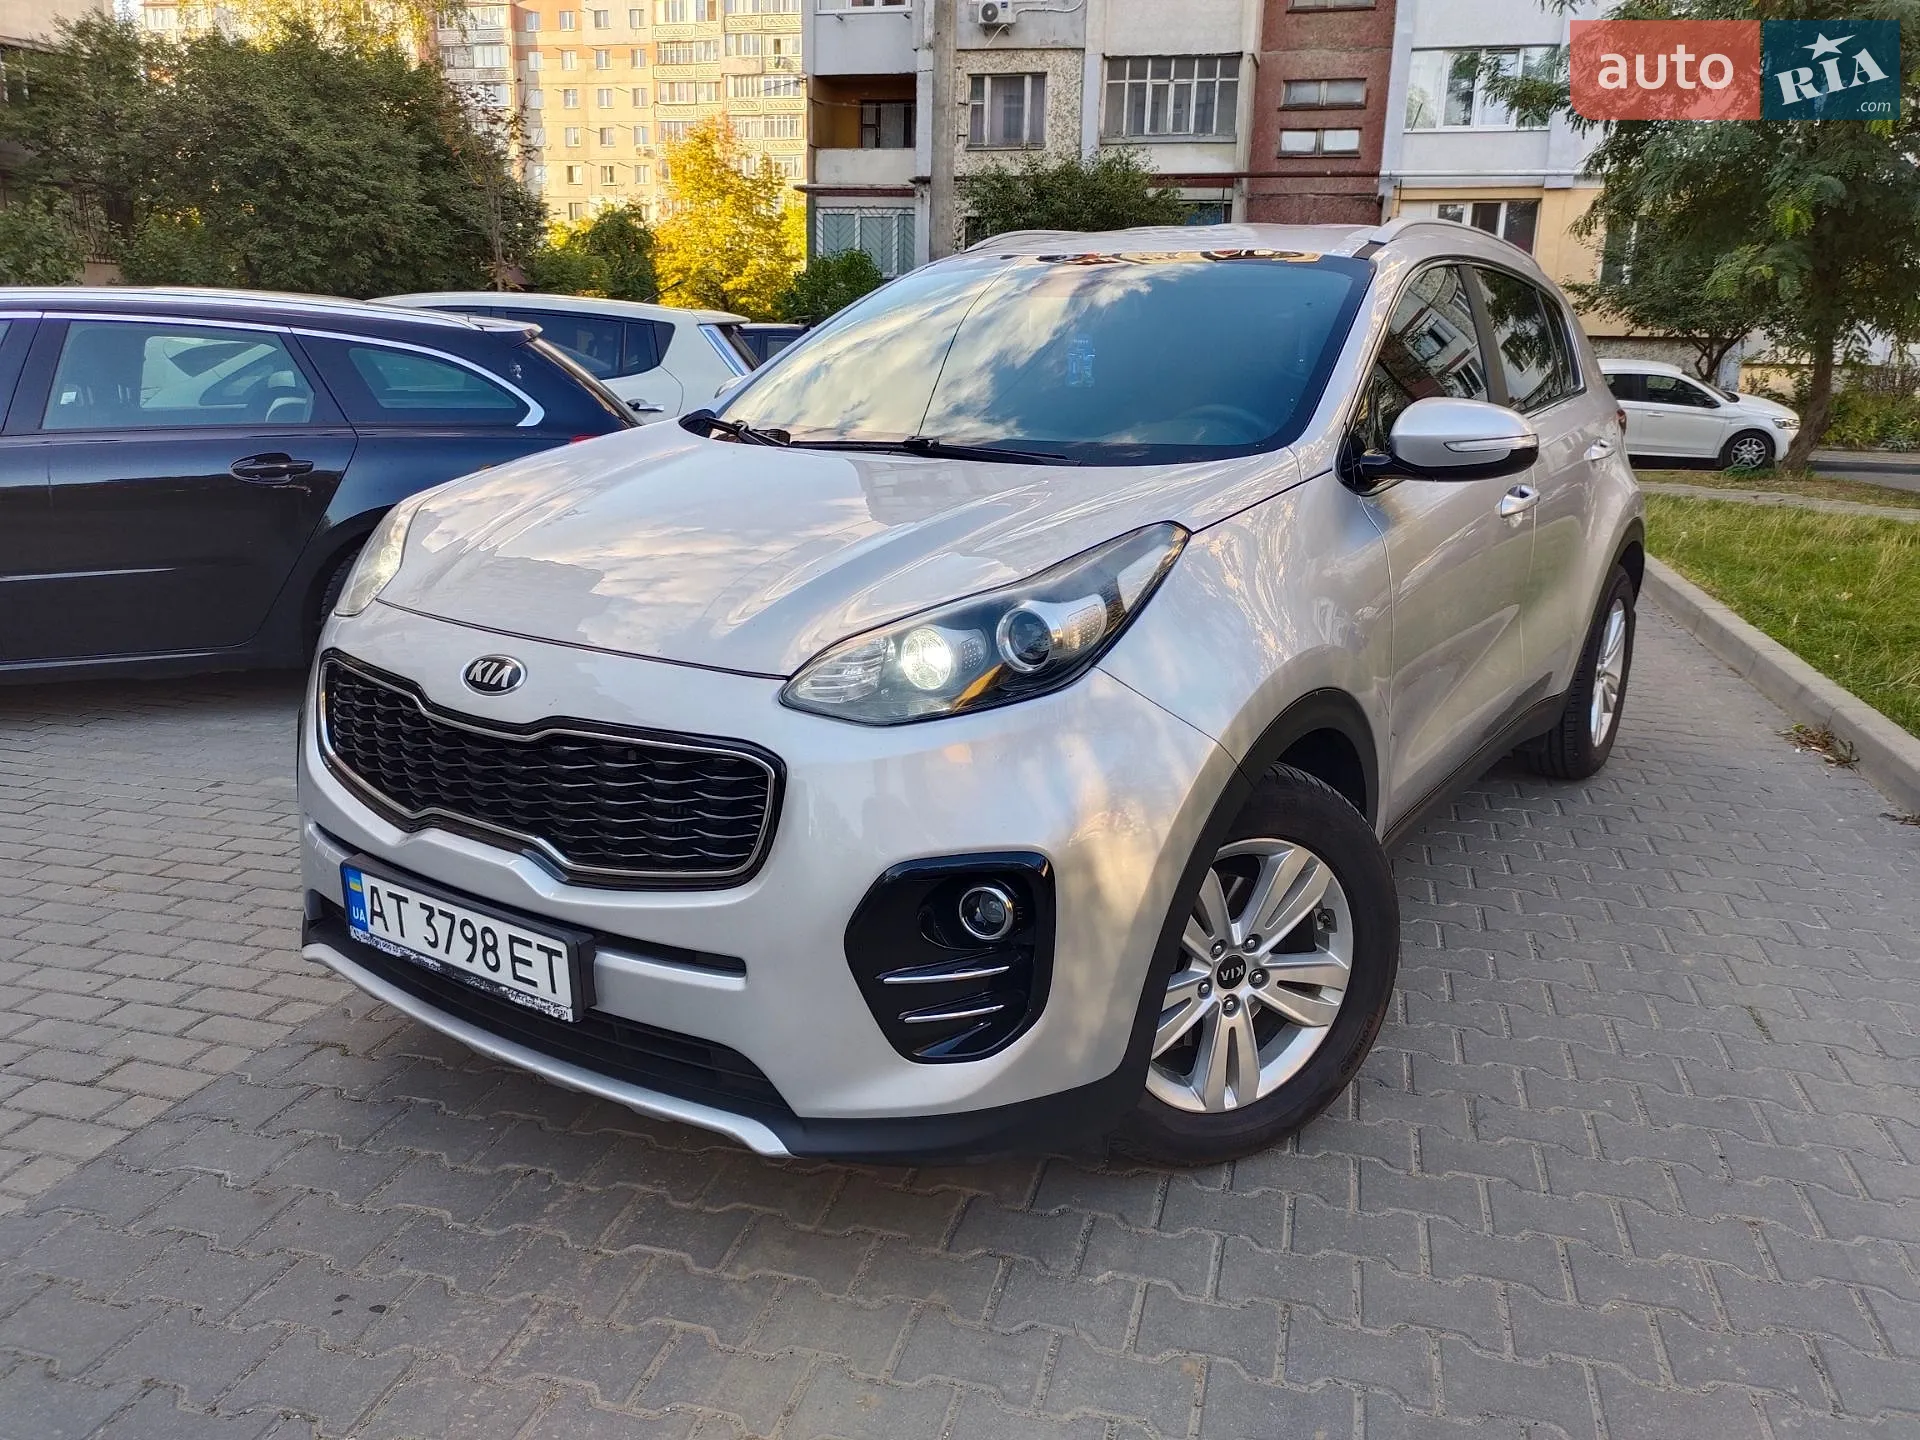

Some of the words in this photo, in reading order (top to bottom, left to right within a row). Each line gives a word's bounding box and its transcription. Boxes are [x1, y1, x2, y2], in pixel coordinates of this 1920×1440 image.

[468, 660, 513, 688] KIA
[352, 905, 366, 924] UA
[369, 885, 409, 938] AT
[419, 902, 501, 973] 3798
[508, 934, 563, 994] ET
[1220, 964, 1244, 981] KIA
